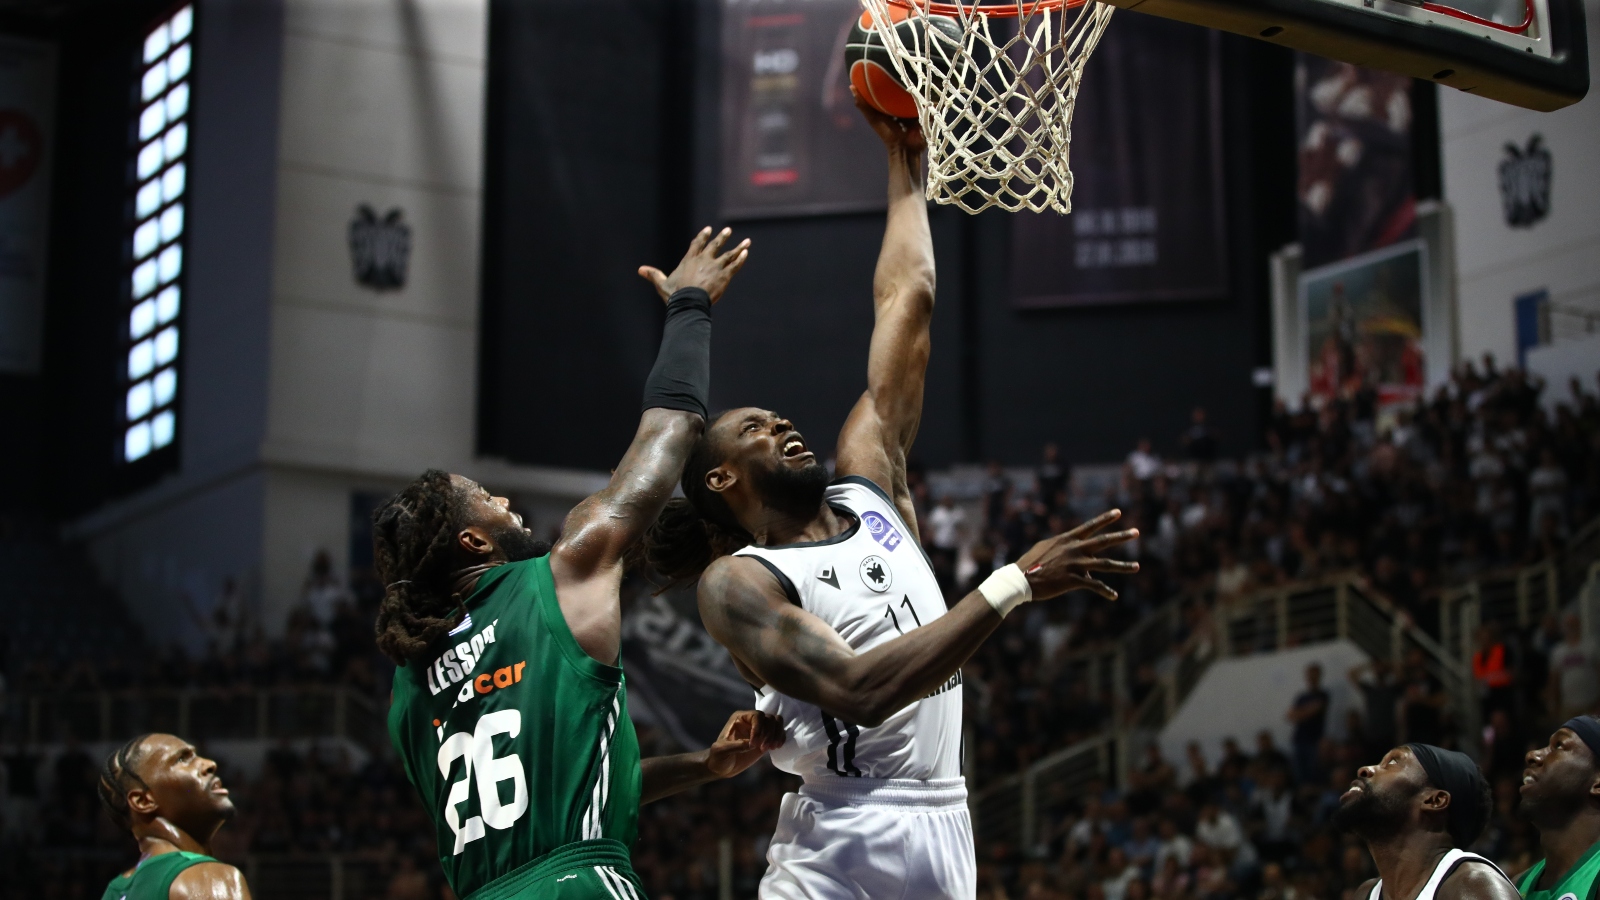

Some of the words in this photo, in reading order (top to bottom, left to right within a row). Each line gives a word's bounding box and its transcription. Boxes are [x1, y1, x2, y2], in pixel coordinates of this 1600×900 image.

[884, 593, 922, 636] 11
[426, 618, 499, 696] LESSOR
[437, 708, 529, 856] 26
